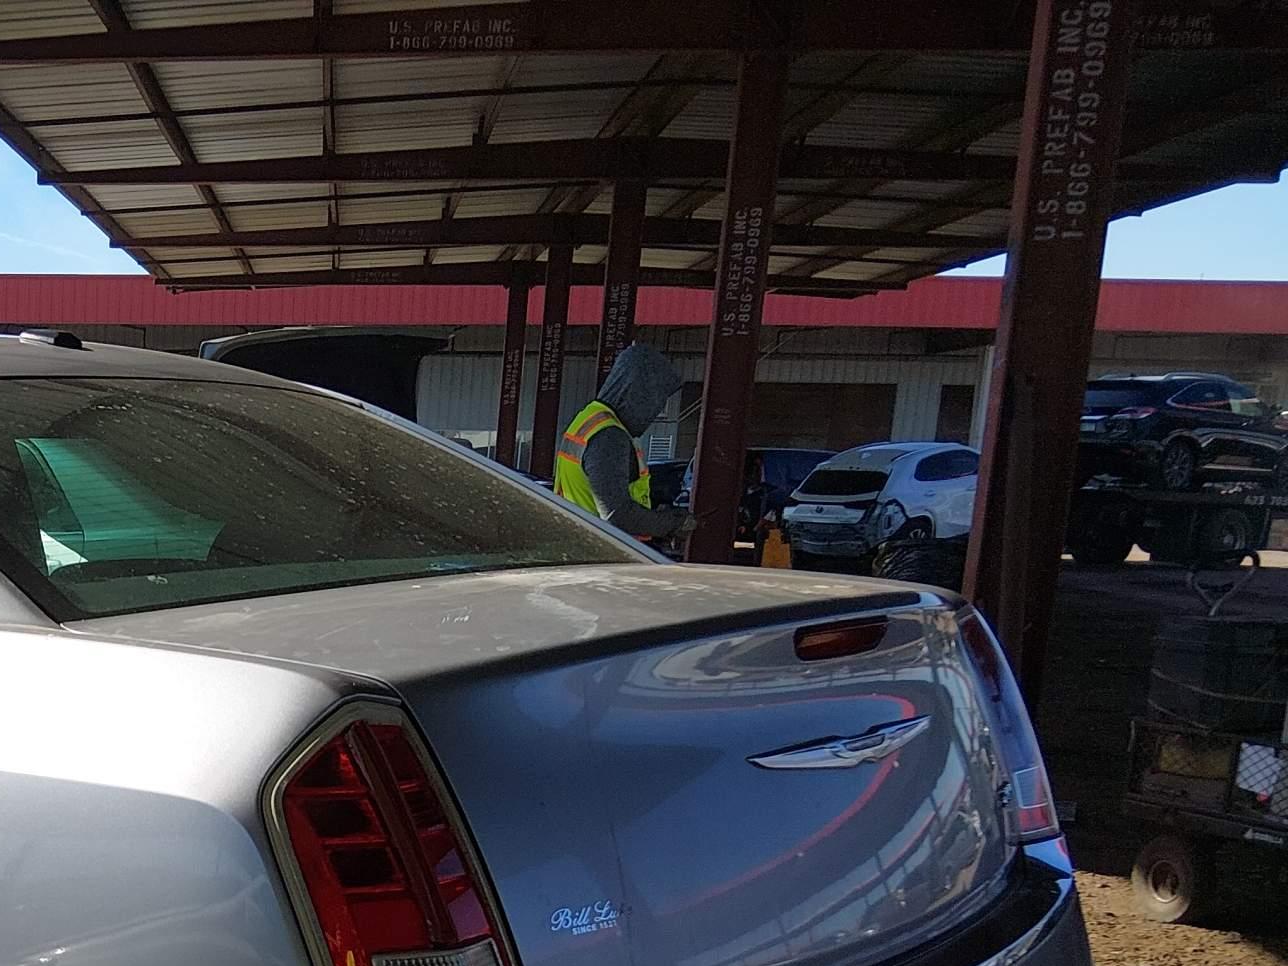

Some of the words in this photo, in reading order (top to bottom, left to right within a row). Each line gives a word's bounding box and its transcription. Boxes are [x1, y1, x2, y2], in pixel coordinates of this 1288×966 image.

[389, 34, 514, 49] 1-866-799-0969
[424, 19, 480, 33] PREFAB
[1041, 69, 1077, 176] PREFAB
[1062, 0, 1112, 239] 1-866-799-0969
[1032, 190, 1062, 242] U.S.
[725, 241, 745, 301] PREFAB
[735, 207, 762, 336] 1-866-799-0969
[551, 906, 591, 931] Bill
[572, 923, 598, 936] SINCE
